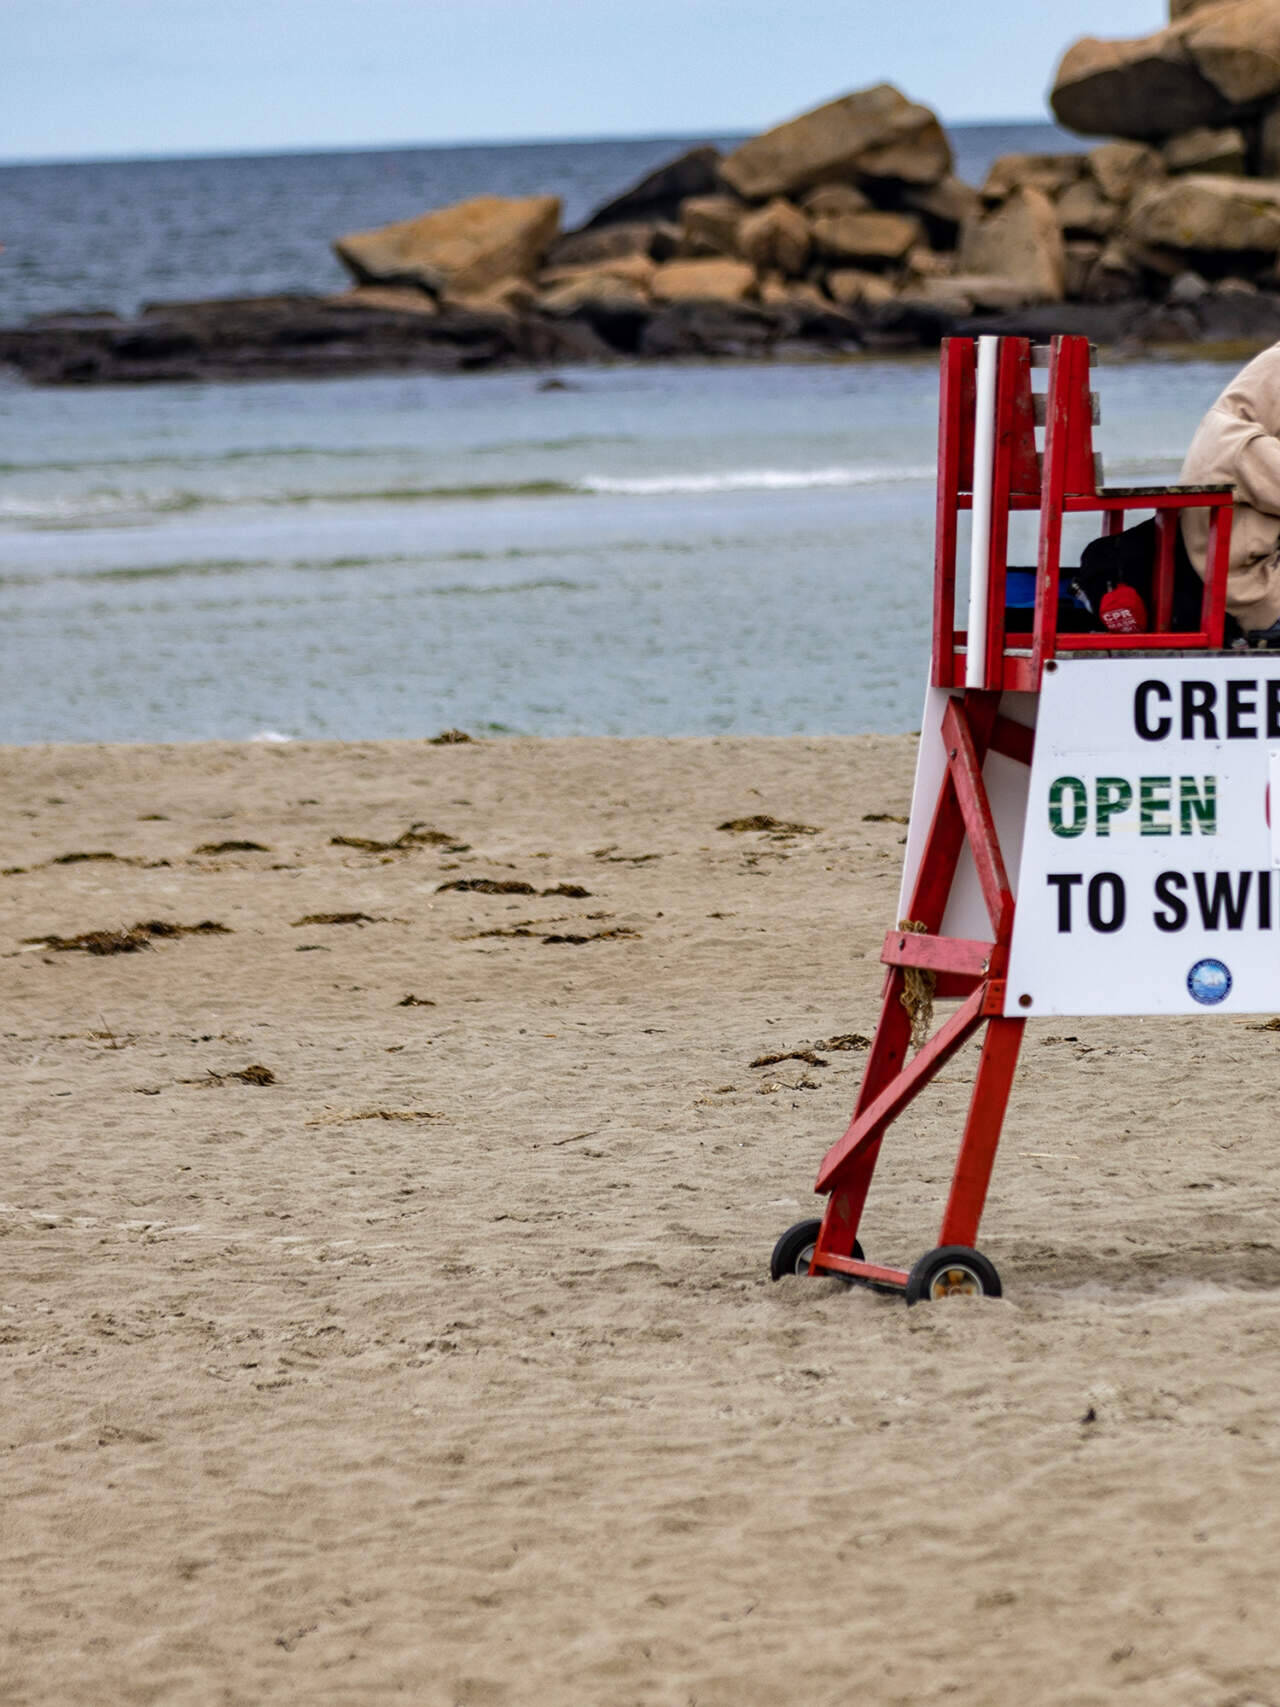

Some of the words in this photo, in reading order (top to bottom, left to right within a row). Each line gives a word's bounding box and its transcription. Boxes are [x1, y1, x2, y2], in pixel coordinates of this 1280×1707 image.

[1102, 609, 1132, 622] CPR
[1048, 775, 1217, 839] OPEN
[1047, 872, 1126, 933] TO
